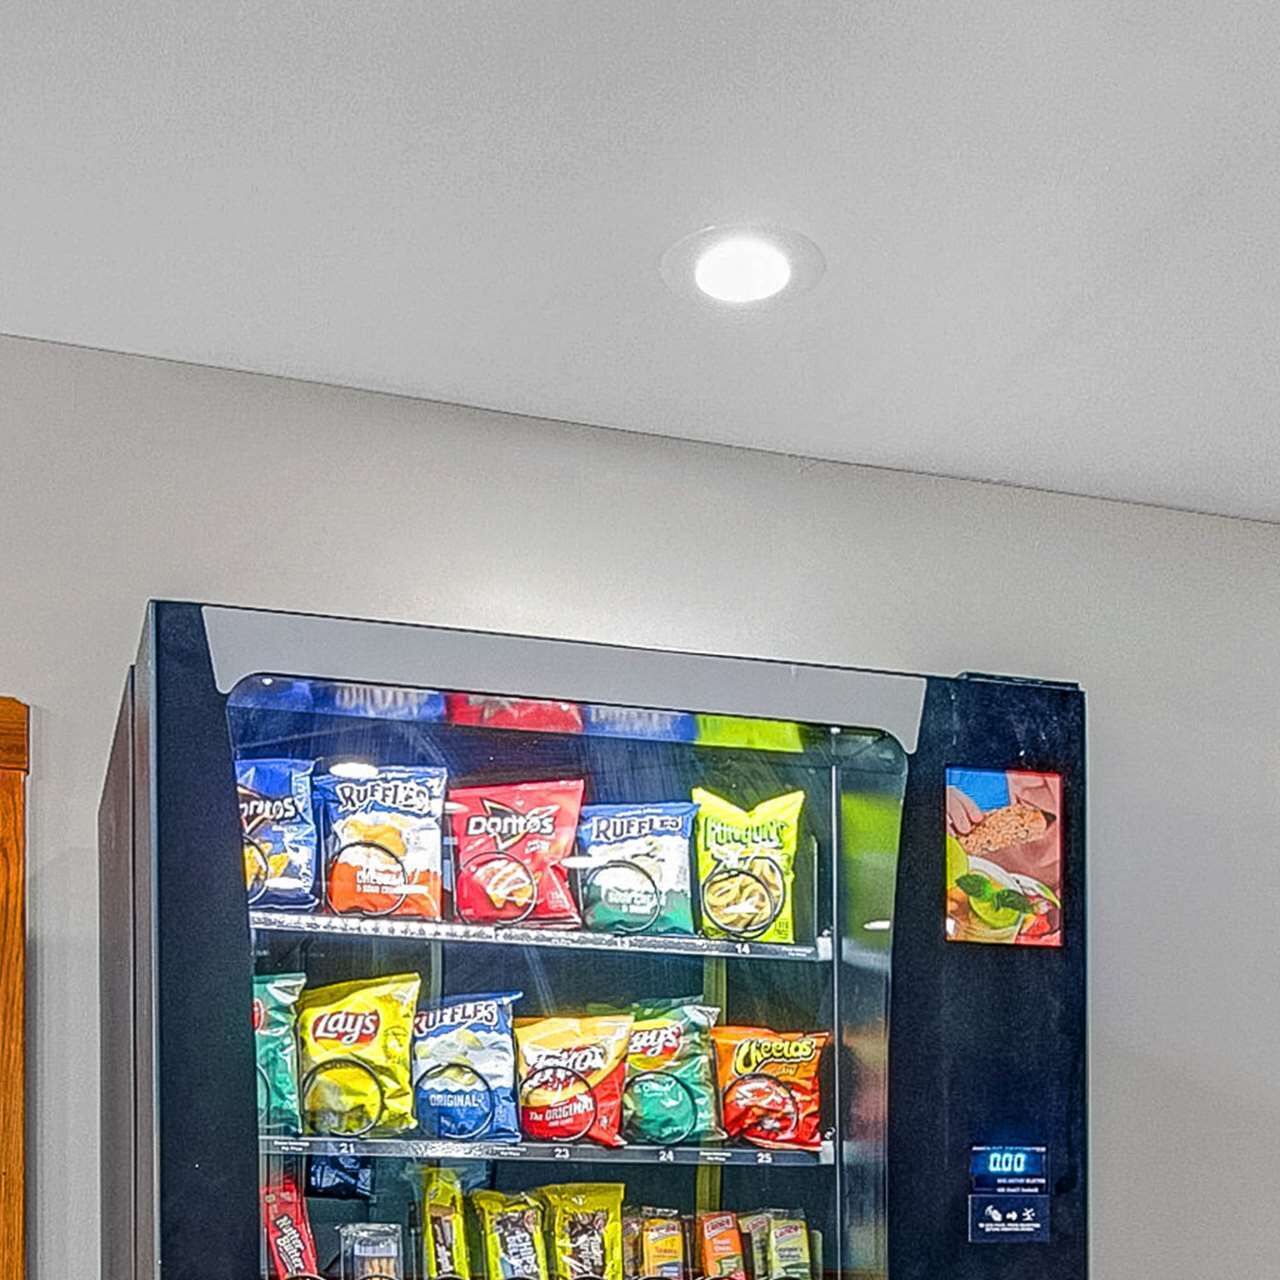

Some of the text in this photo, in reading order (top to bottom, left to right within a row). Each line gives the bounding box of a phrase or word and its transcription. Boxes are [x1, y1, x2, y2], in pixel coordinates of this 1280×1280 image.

[735, 943, 751, 955] 14
[414, 1001, 498, 1037] RUFFLES
[430, 1093, 481, 1107] ORIGINAL
[339, 1143, 355, 1154] 21
[554, 1148, 570, 1160] 23
[659, 1151, 674, 1162] 24
[757, 1153, 773, 1164] 25
[519, 1231, 536, 1274] CHIPS
